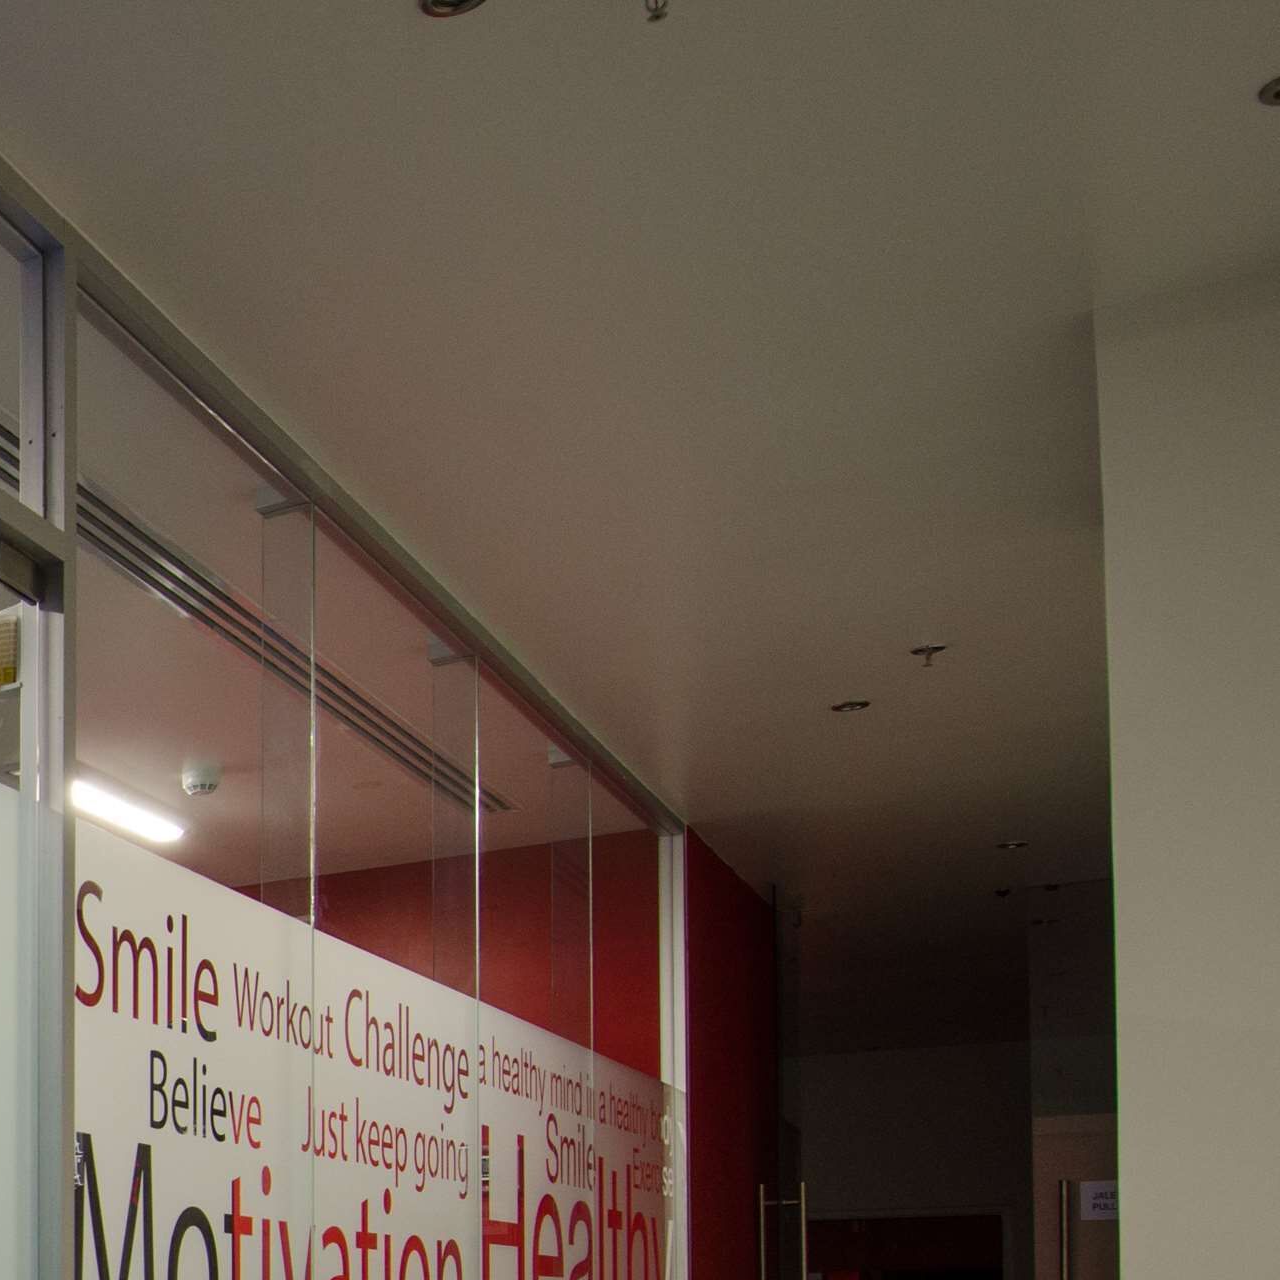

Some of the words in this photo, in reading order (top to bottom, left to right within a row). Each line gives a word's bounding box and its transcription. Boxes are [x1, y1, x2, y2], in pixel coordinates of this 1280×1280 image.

[74, 879, 220, 1043] Smile
[232, 962, 335, 1060] Workout
[344, 988, 470, 1115] Challenge
[149, 1049, 263, 1150] Believe
[300, 1085, 349, 1163] Just
[355, 1096, 409, 1189] keep
[413, 1122, 469, 1200] going
[478, 1043, 487, 1086] a
[491, 1035, 547, 1117] healthy
[550, 1064, 583, 1117] mind
[599, 1089, 607, 1125] a
[546, 1112, 597, 1192] Smile
